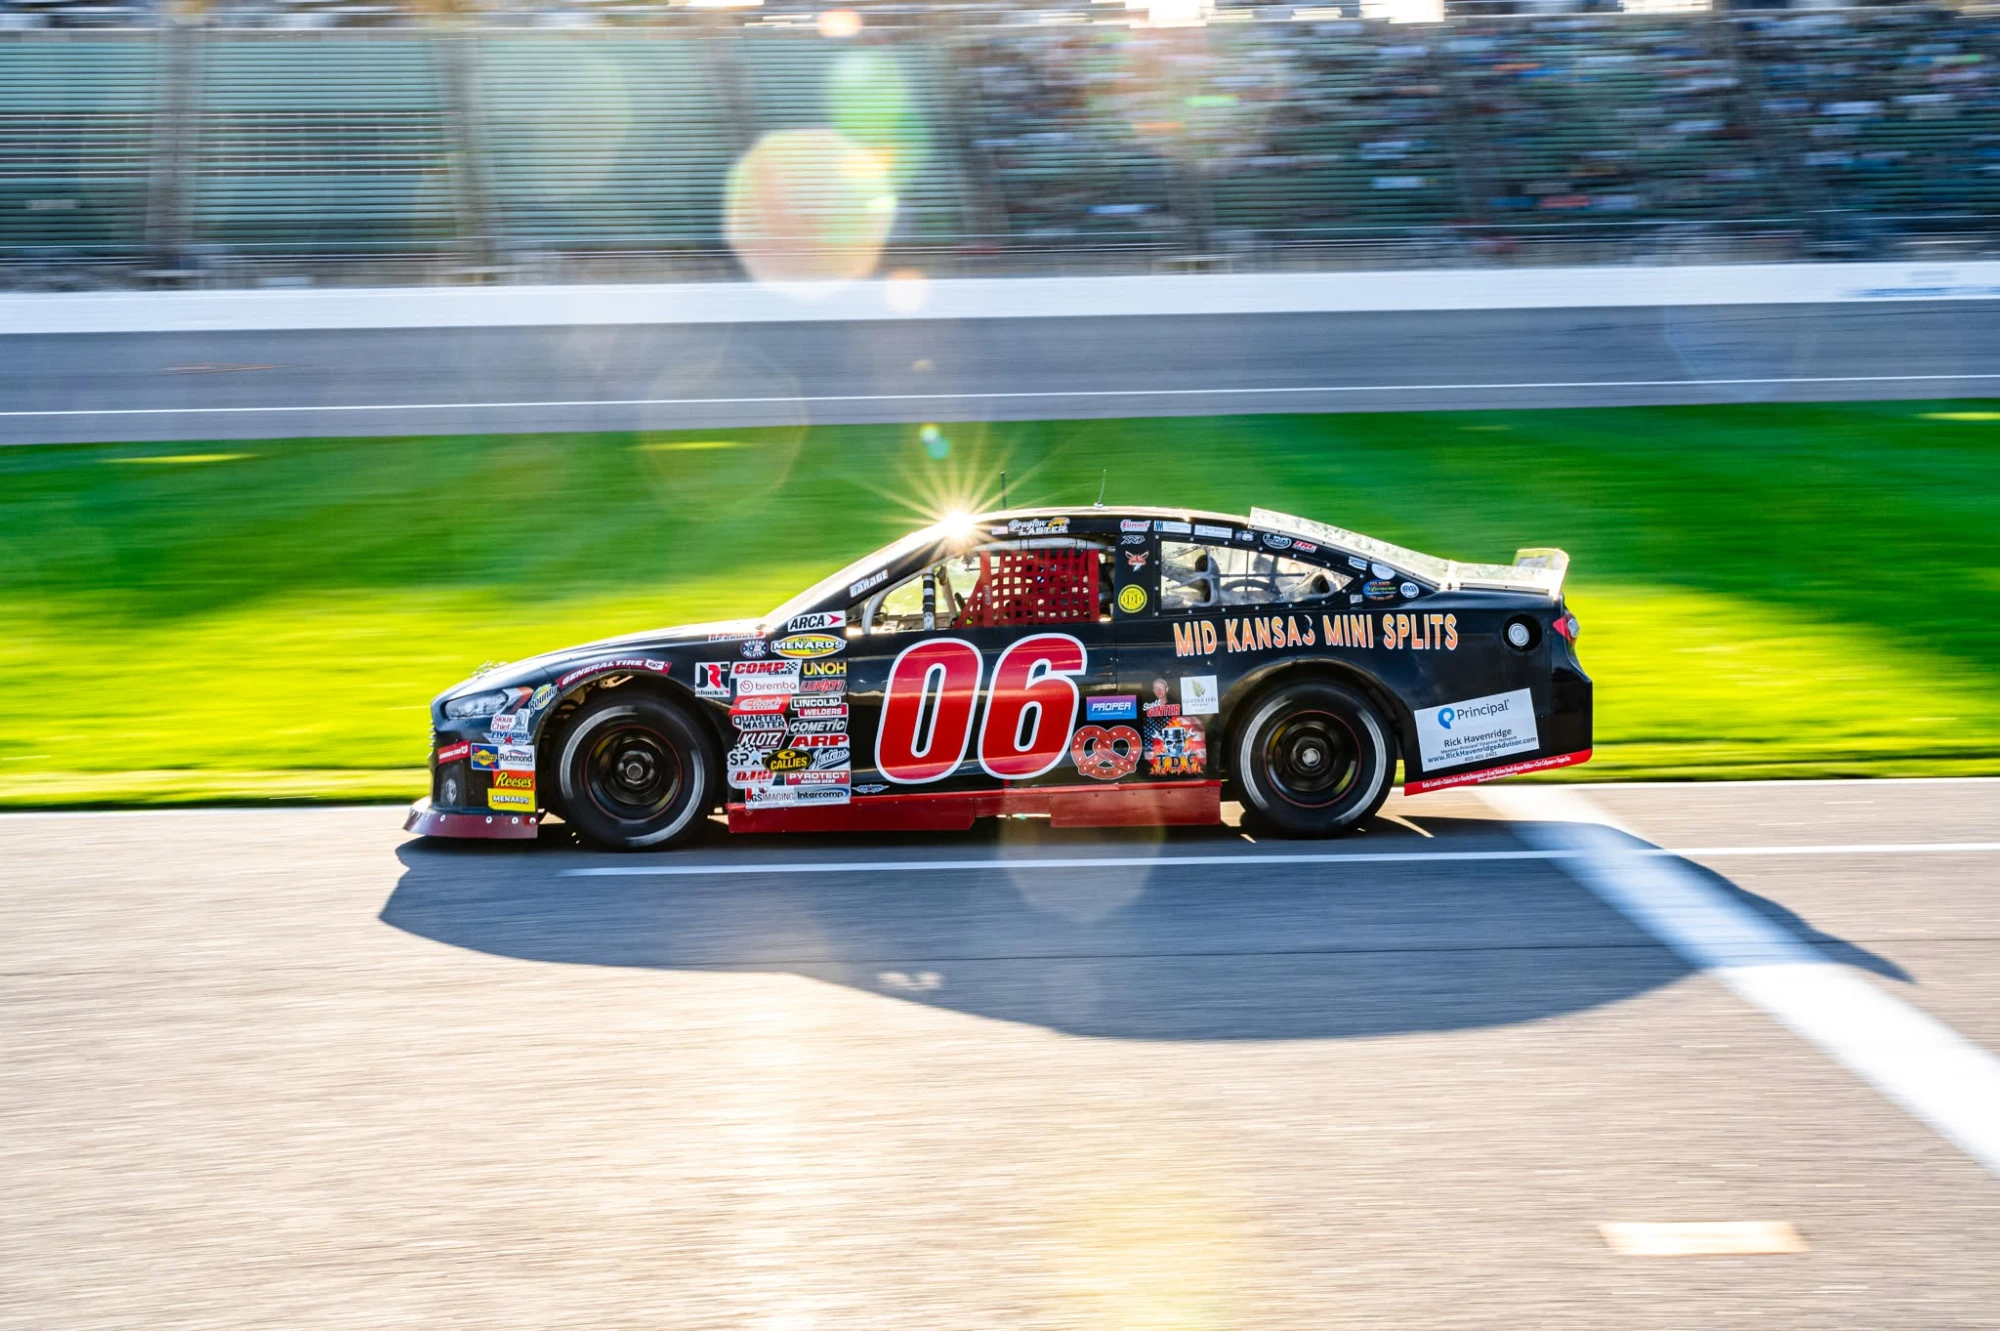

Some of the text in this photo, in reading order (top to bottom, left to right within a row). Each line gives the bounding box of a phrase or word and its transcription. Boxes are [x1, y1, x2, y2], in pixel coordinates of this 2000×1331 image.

[790, 615, 825, 630] ARCA
[1173, 620, 1217, 657] MID
[1323, 614, 1373, 649] MINI
[1383, 613, 1458, 650] SPLITS
[773, 641, 843, 650] MENARDS
[562, 661, 613, 685] GENERAL
[734, 662, 785, 675] COMP
[803, 661, 847, 675] UNOH
[755, 682, 797, 690] brembo
[529, 685, 557, 714] Bounty
[794, 698, 838, 707] LINCOLN
[1143, 699, 1161, 711] Scott
[875, 633, 1087, 784] 06
[1092, 702, 1131, 711] PROPER
[1147, 704, 1180, 717] GINTER
[1457, 699, 1509, 720] Principal
[492, 722, 510, 730] Chief
[733, 715, 782, 726] QUARTER
[743, 721, 785, 729] MASTER
[791, 719, 845, 731] COMETIC
[741, 732, 782, 746] KLOTZ
[791, 735, 848, 747] ARP
[1444, 728, 1512, 747] Rick Havenridge
[1428, 736, 1537, 763] www.RickHavenridgeAdvisor.com
[500, 752, 532, 762] Richmond
[770, 757, 808, 770] CALLIES
[813, 749, 848, 769] Jostens
[496, 772, 532, 788] Reese's
[790, 771, 846, 779] PYROTECT
[492, 795, 529, 804] MENARDS
[797, 791, 843, 799] Intercomp
